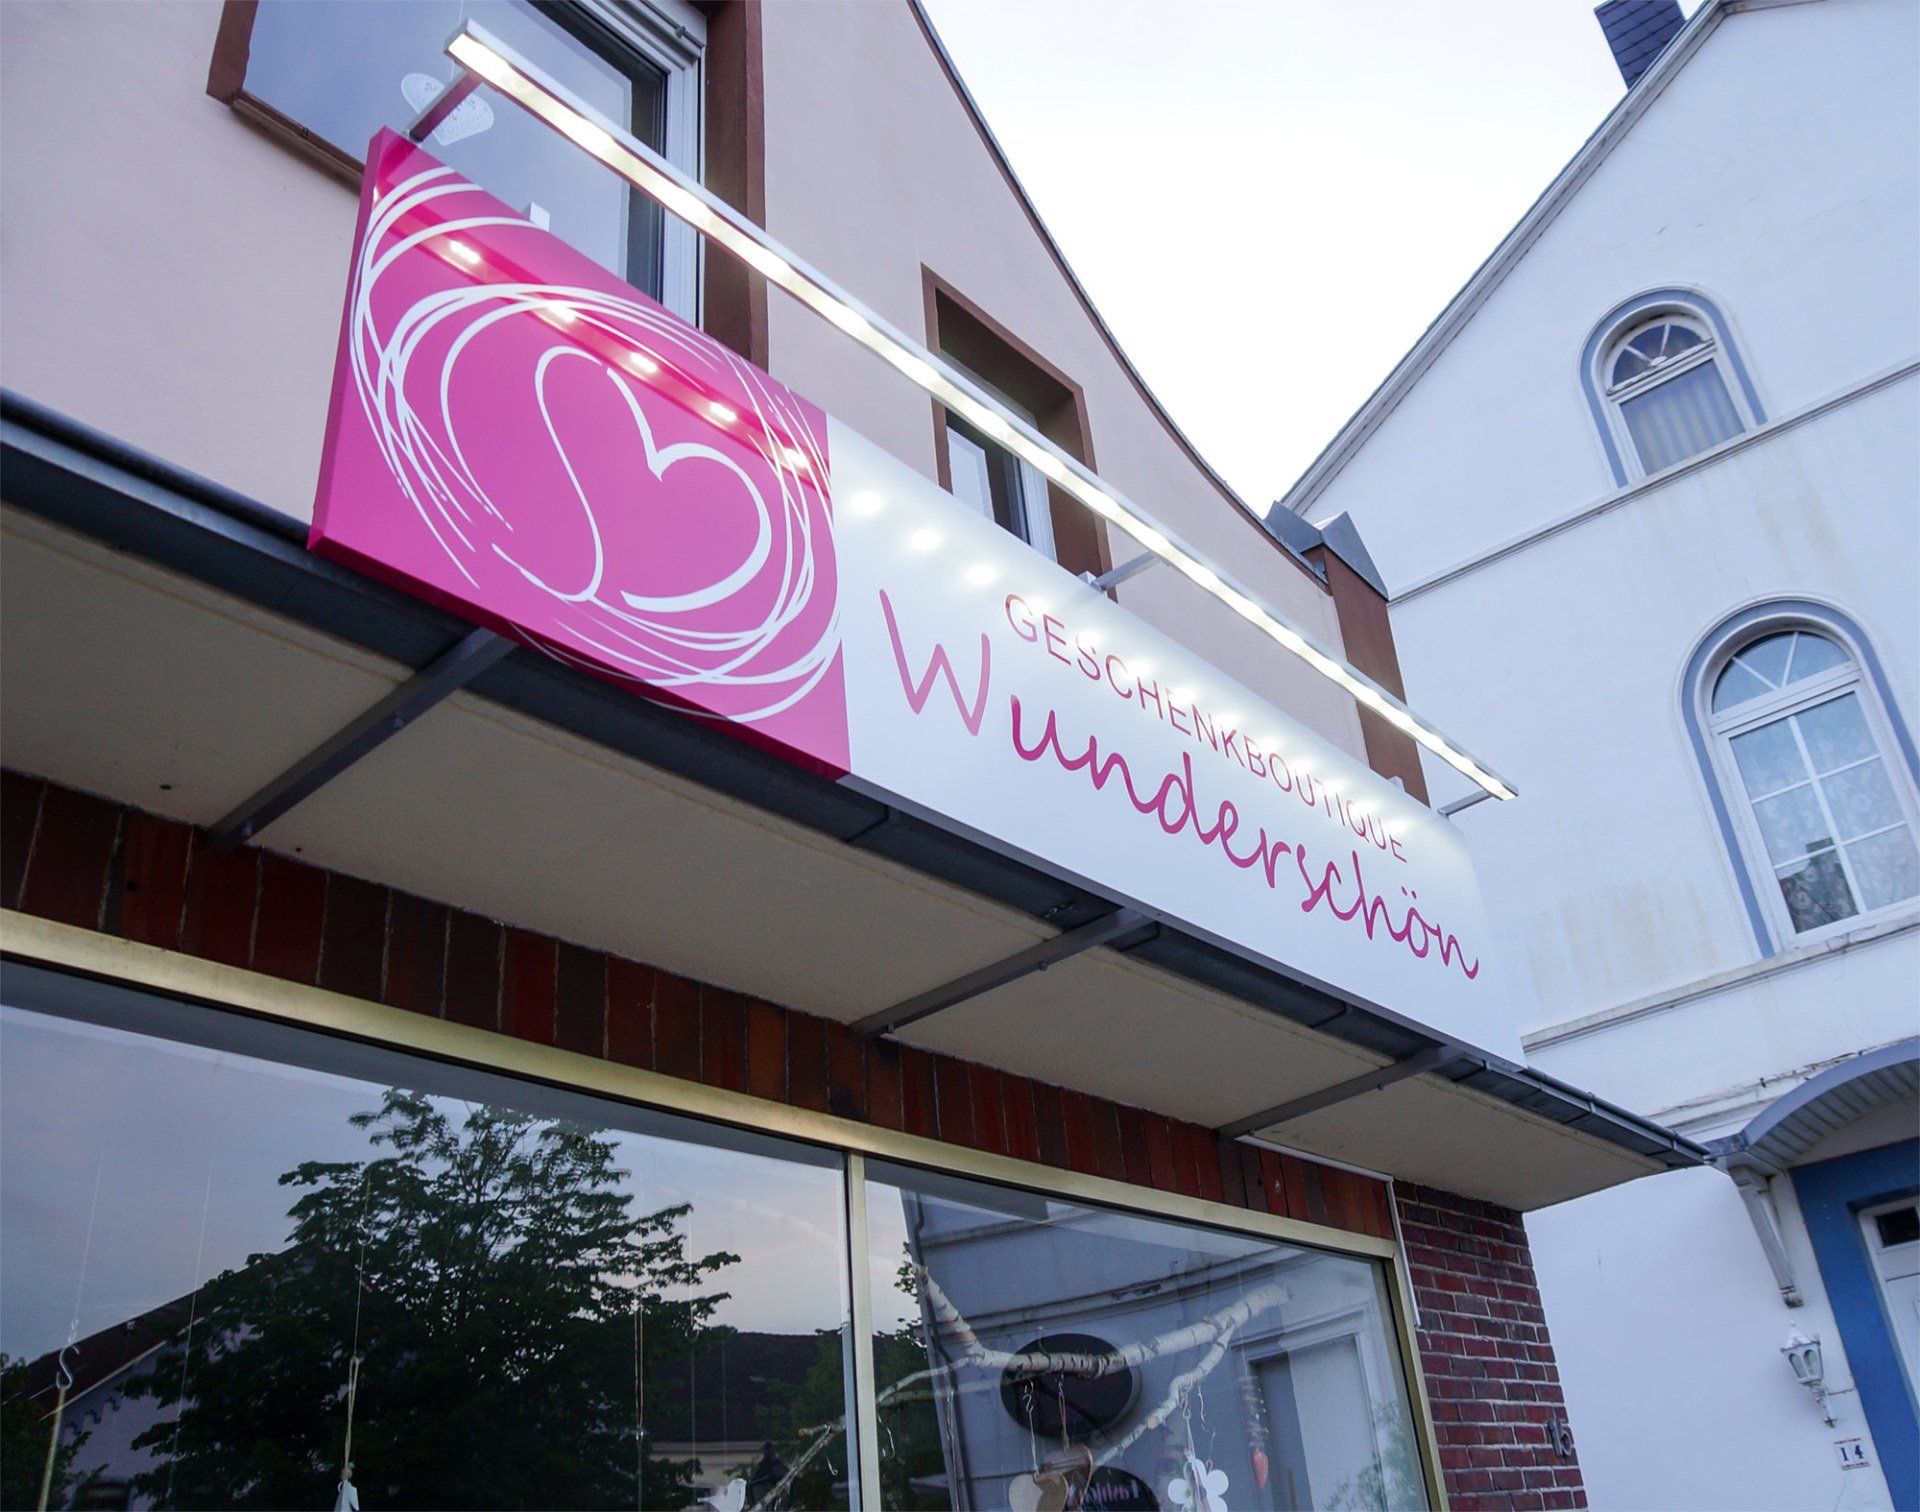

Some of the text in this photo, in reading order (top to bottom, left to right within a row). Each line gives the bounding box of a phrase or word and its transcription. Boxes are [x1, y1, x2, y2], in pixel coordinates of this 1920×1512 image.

[879, 589, 1479, 979] Wunderschön
[1005, 594, 1407, 863] GESCHENKBOUTIQUE
[1840, 1444, 1865, 1462] 14
